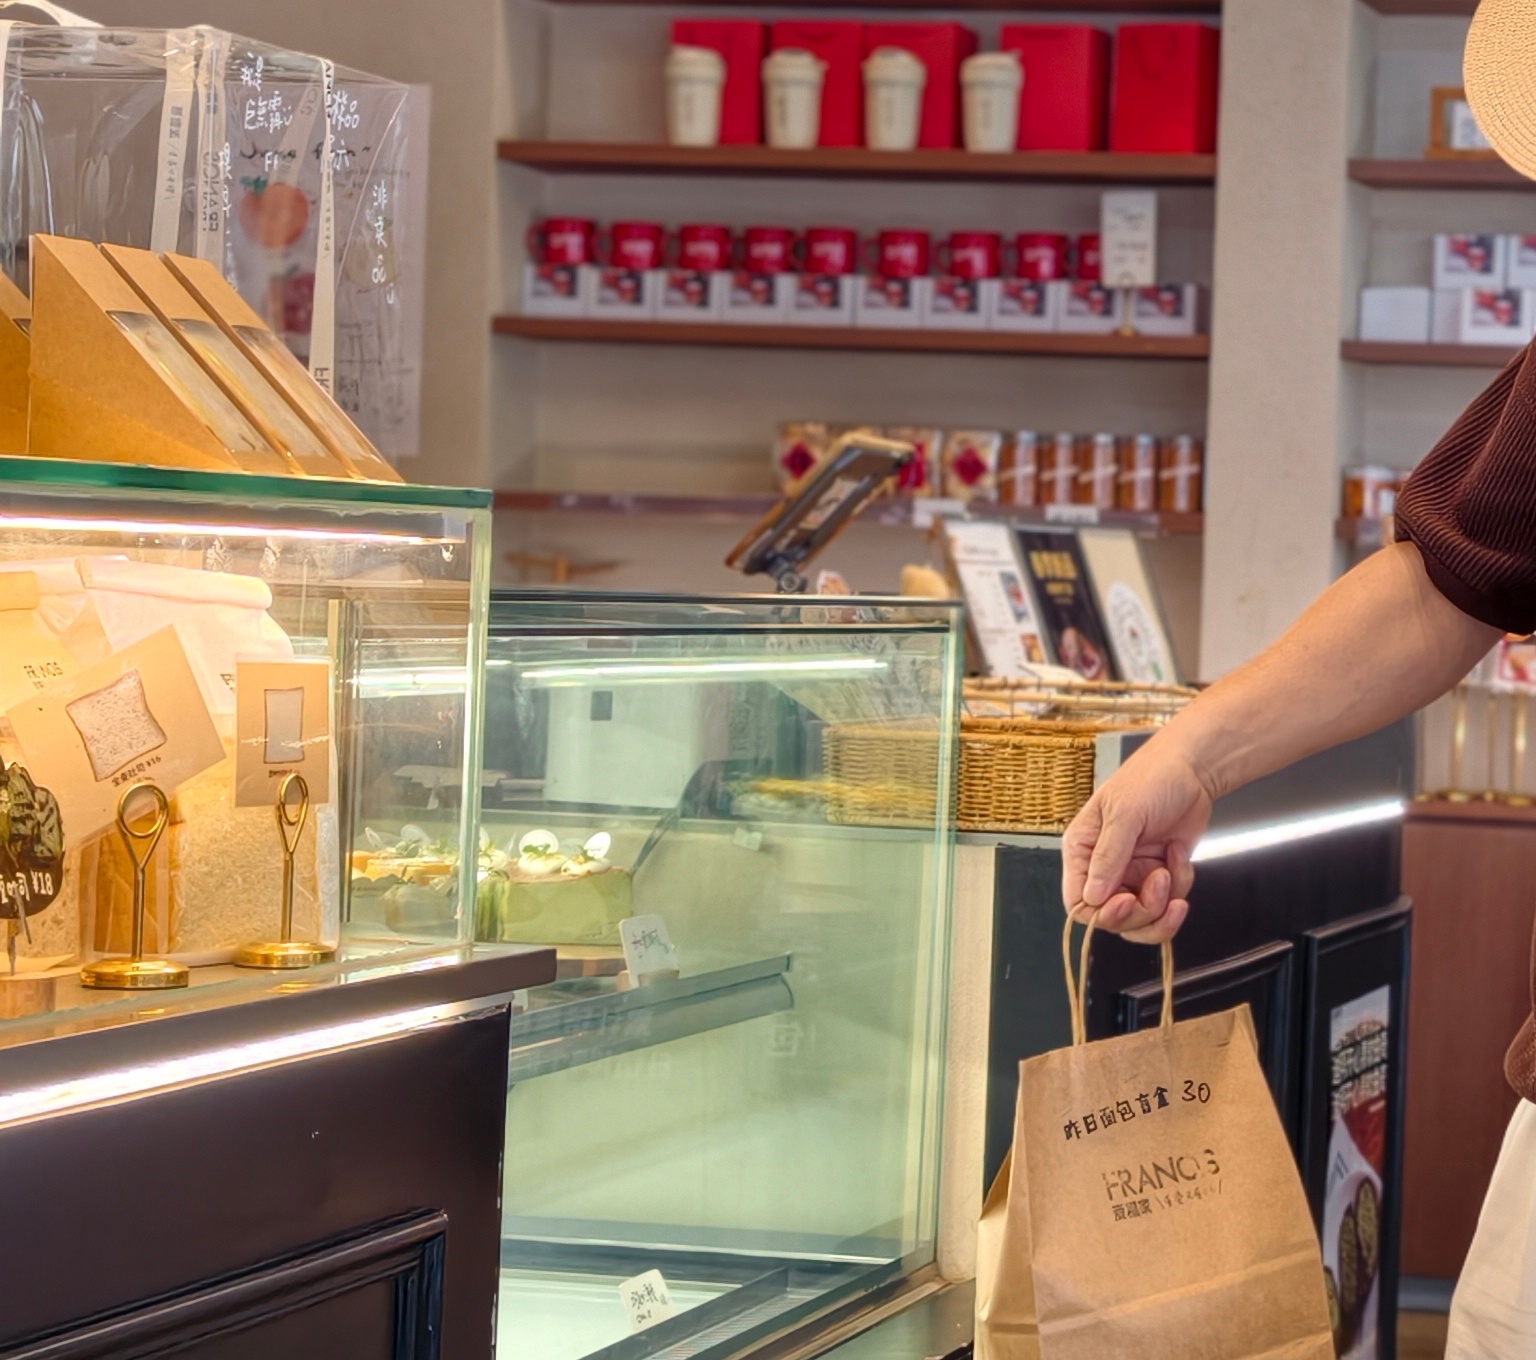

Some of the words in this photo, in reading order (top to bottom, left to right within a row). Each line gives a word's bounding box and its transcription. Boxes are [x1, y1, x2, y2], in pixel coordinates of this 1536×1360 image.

[30, 868, 54, 896] ¥18
[1063, 1086, 1169, 1140] 昨日面包盲盒
[1181, 1080, 1211, 1103] 30
[1101, 1149, 1220, 1201] FRANCS
